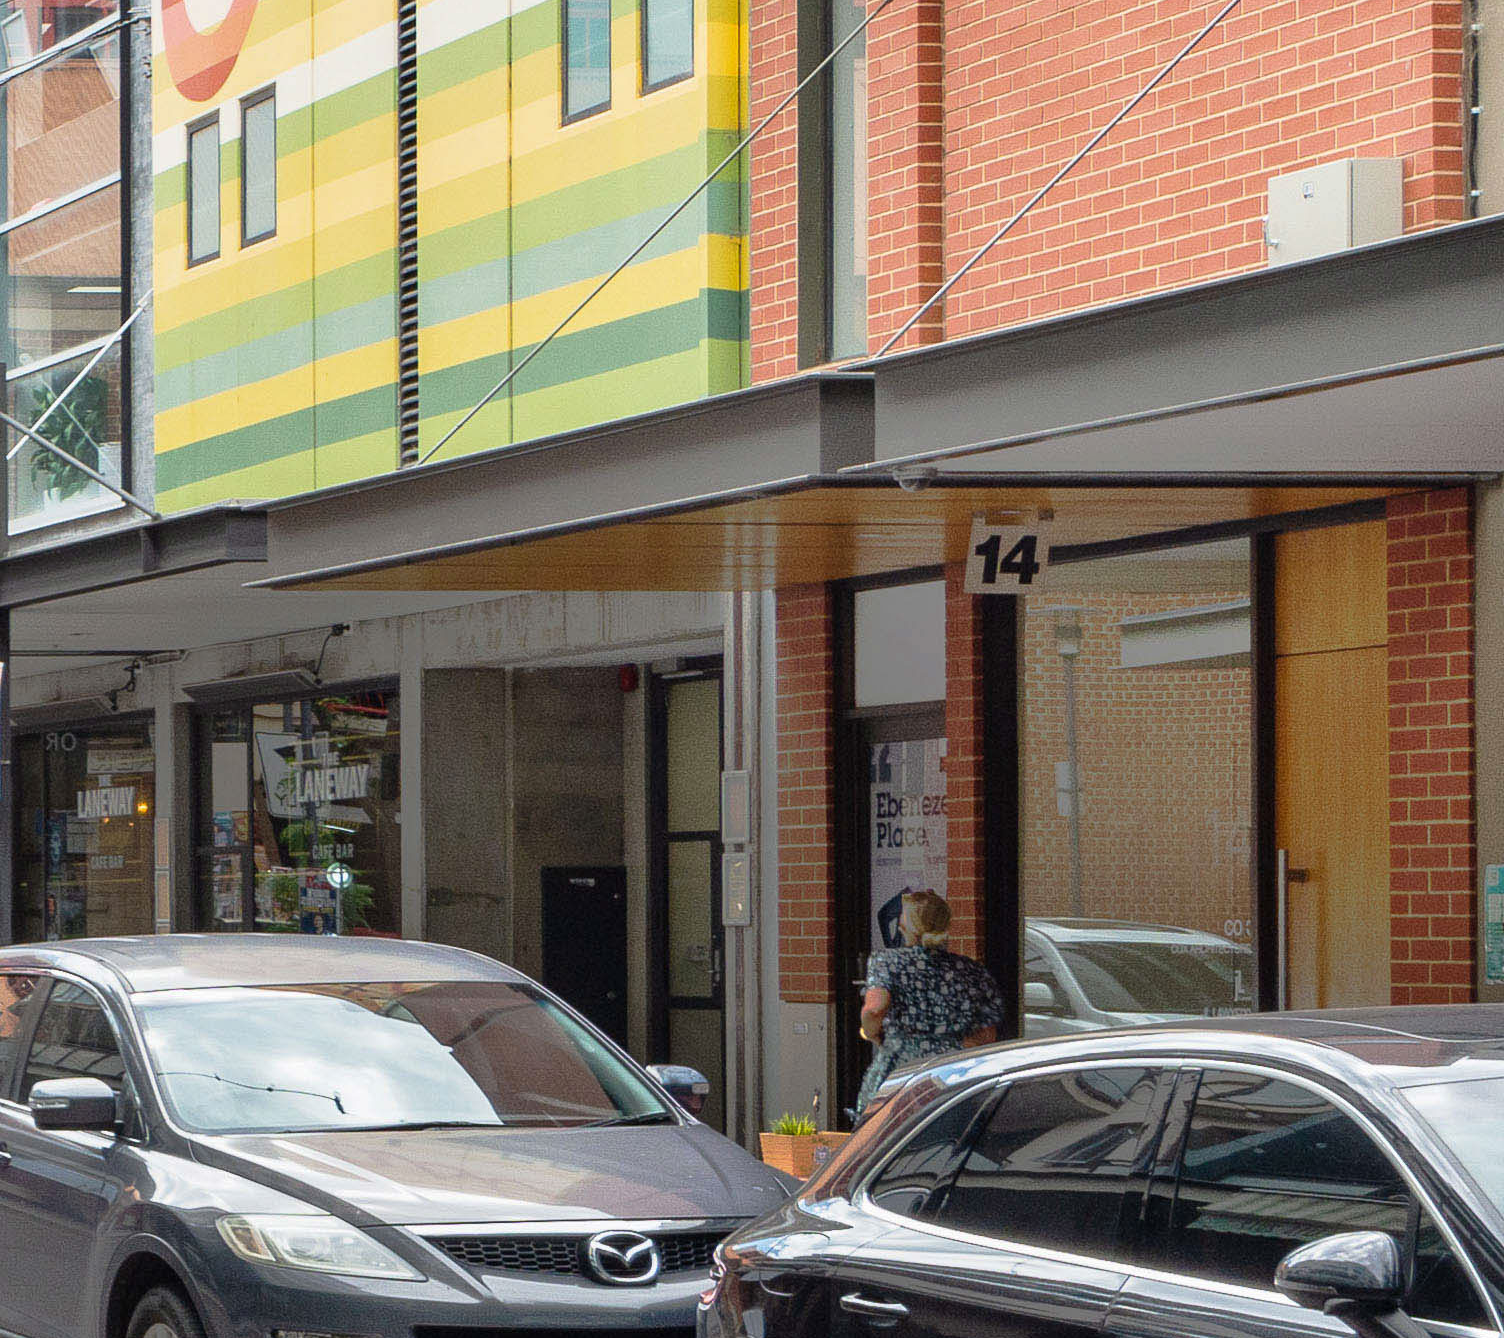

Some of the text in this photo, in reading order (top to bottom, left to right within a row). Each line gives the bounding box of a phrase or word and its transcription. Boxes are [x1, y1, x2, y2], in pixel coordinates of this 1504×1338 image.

[975, 535, 1040, 584] 14
[296, 764, 370, 801] LANEWAY
[77, 786, 135, 819] LANEWAY
[876, 792, 948, 819] Ebeneze
